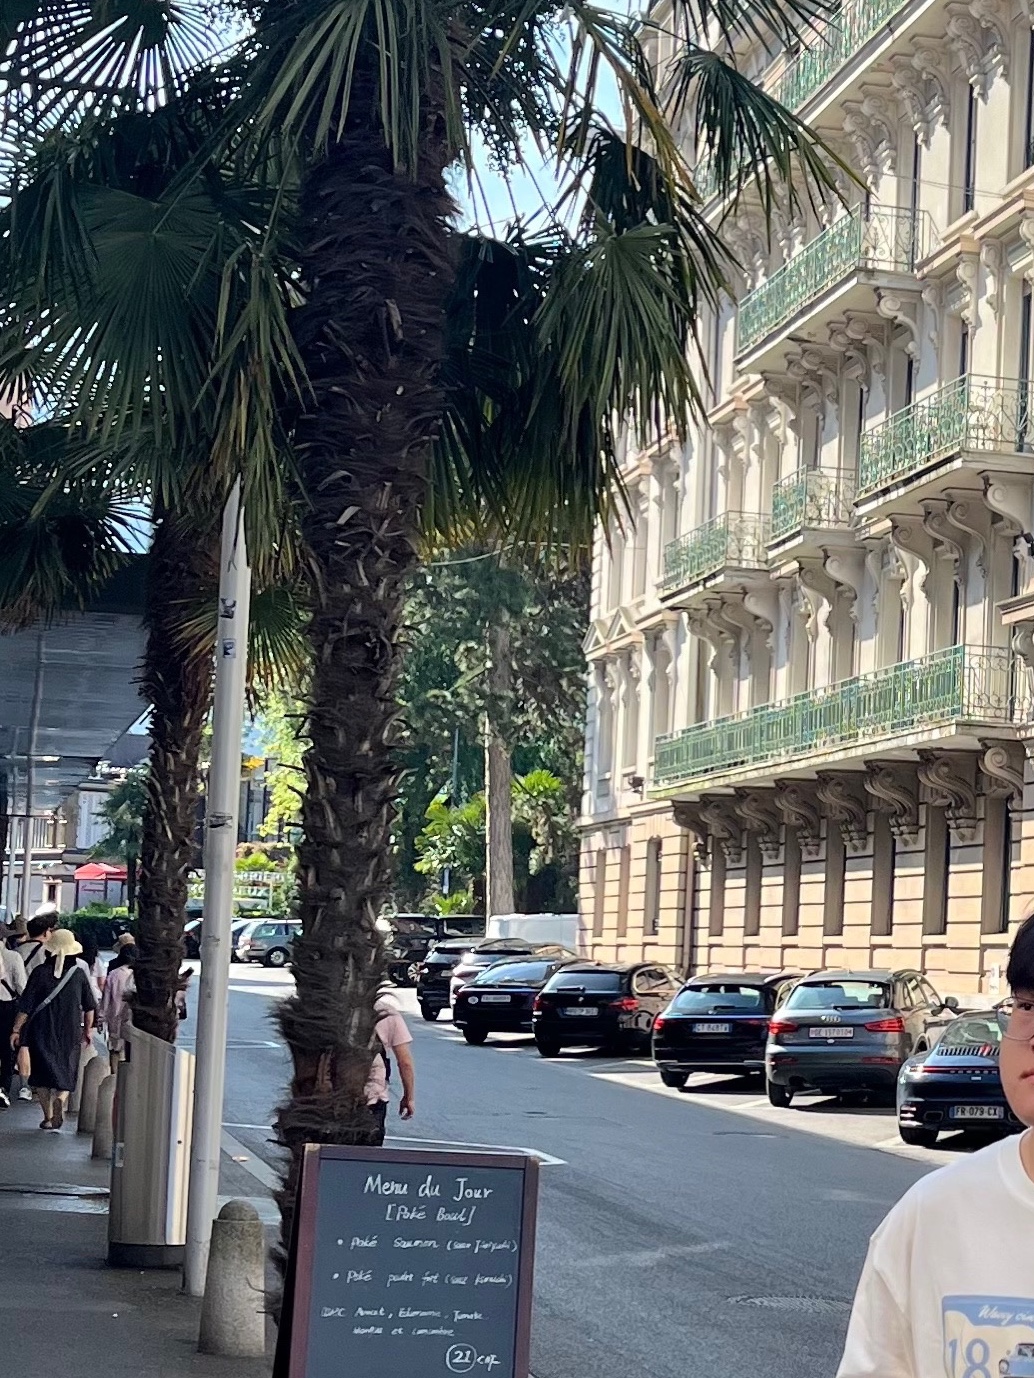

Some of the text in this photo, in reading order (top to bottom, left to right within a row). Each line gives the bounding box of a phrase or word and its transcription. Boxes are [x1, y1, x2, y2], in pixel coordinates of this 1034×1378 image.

[363, 1173, 494, 1201] Menu du Jour
